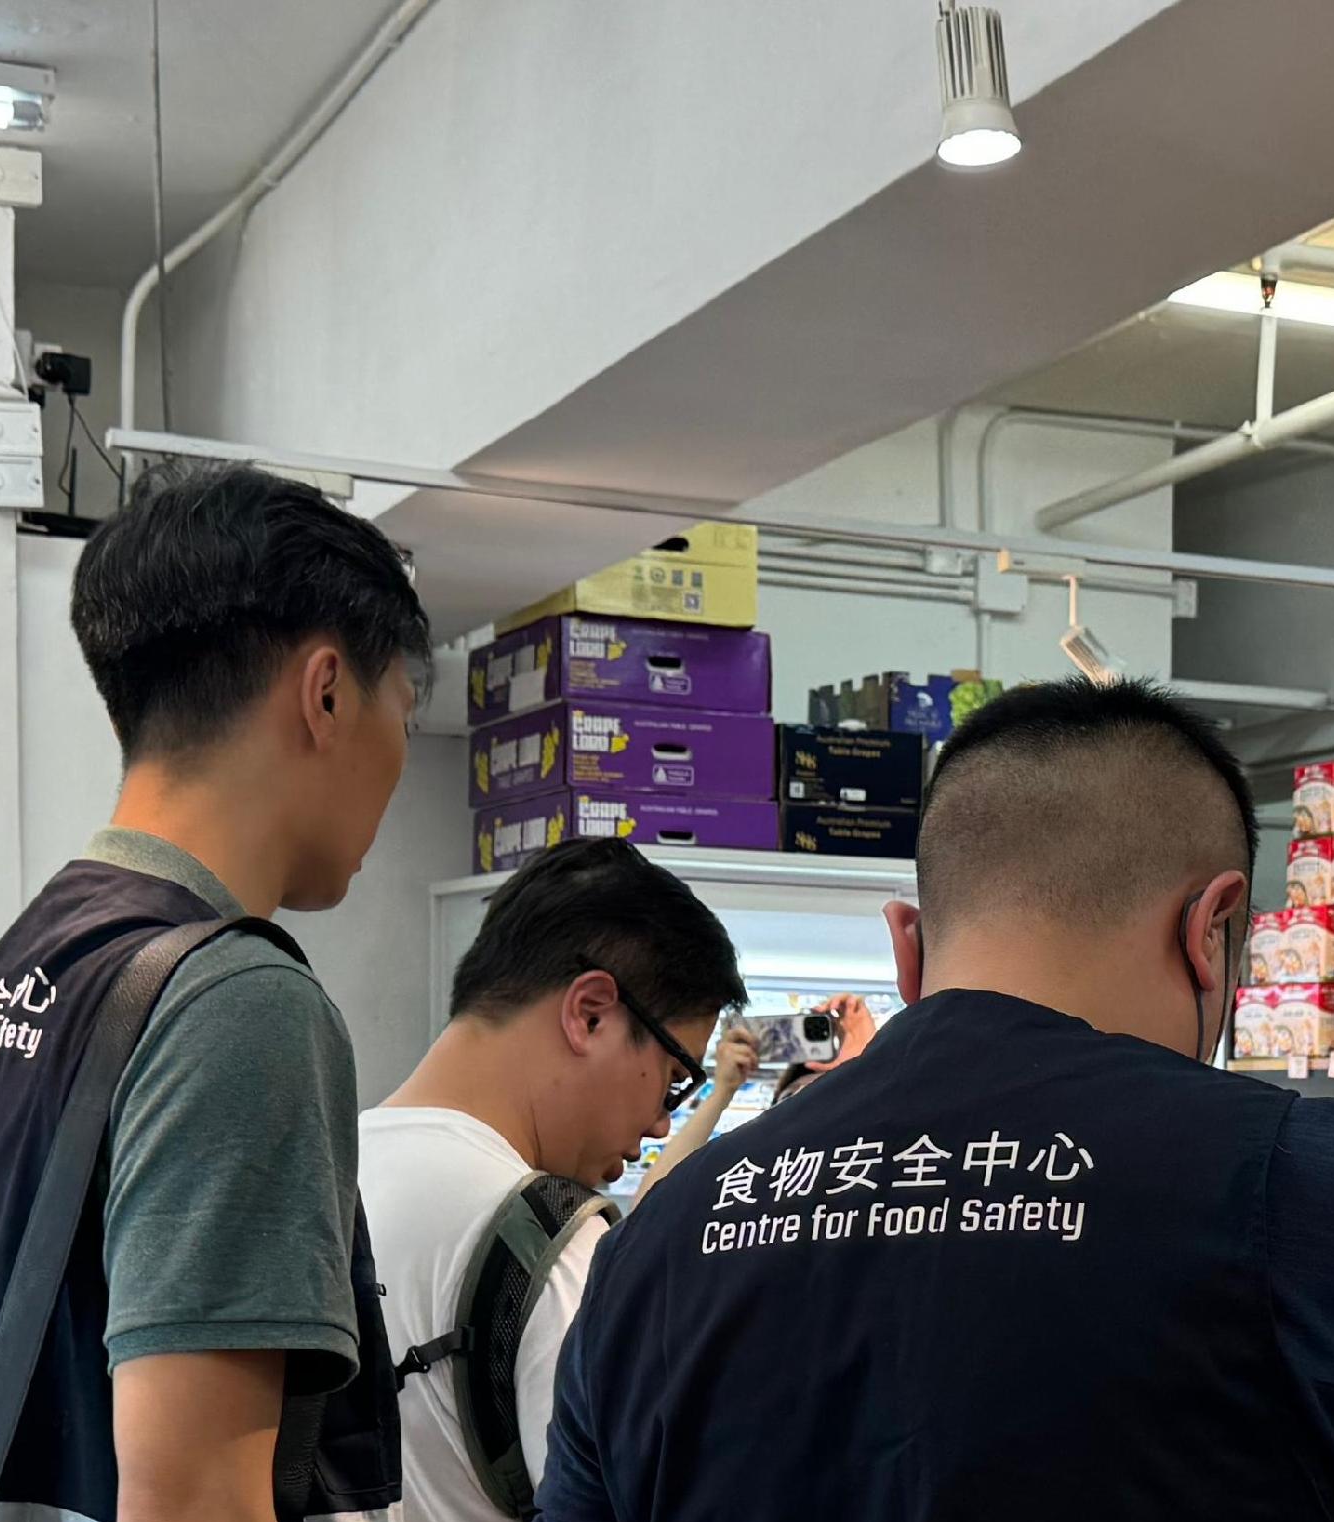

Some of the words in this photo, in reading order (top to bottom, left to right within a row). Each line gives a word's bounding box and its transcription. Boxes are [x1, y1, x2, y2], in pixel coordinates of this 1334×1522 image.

[712, 1131, 1095, 1210] 食物安全中心
[701, 1213, 801, 1254] Centre
[812, 1204, 859, 1240] for
[867, 1198, 949, 1237] Food
[959, 1195, 1085, 1241] Safety
